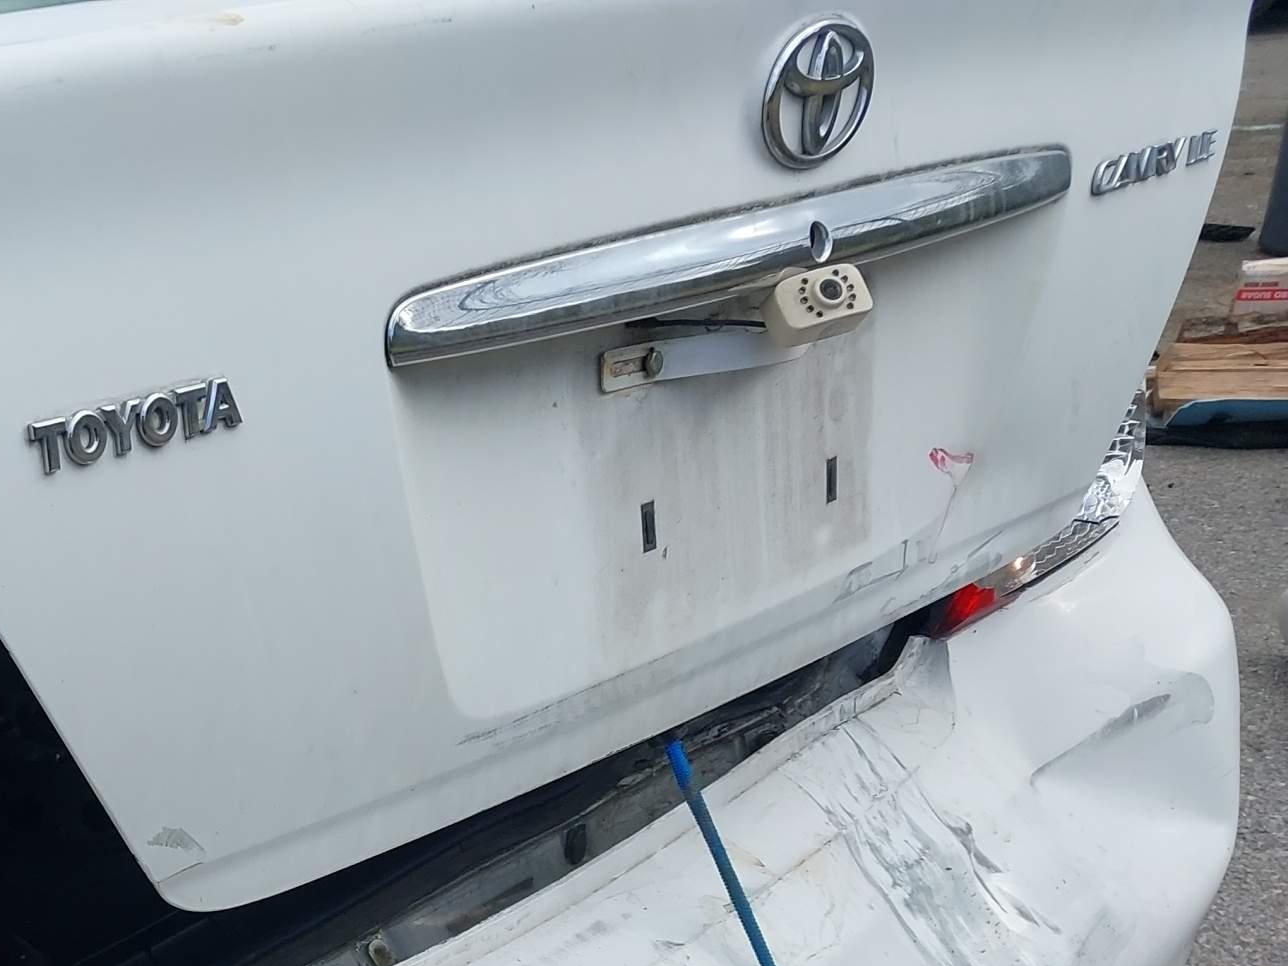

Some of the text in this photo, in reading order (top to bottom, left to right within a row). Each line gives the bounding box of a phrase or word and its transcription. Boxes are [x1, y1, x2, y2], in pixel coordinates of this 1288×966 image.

[1091, 129, 1218, 196] CAMRY LE
[27, 376, 243, 475] TOYOTA
